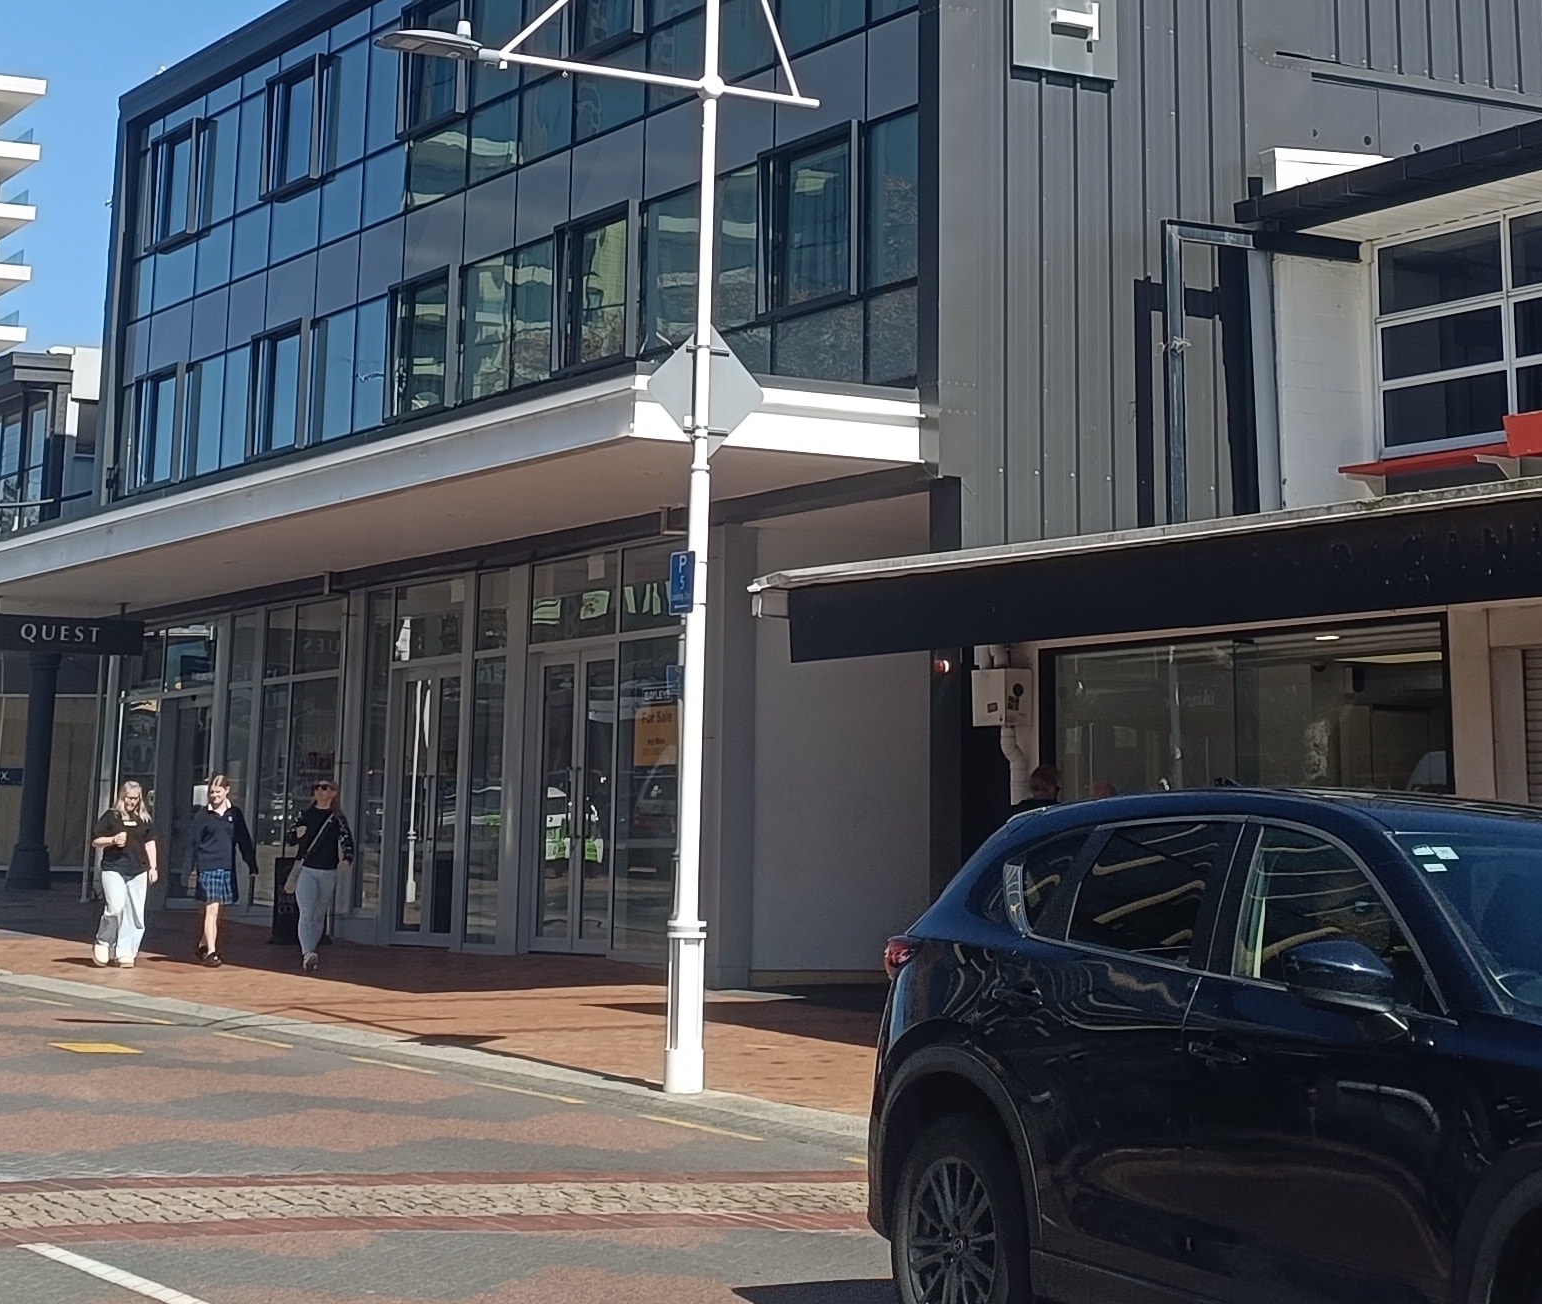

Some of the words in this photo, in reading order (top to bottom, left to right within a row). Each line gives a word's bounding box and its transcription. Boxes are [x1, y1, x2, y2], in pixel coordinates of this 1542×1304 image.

[678, 554, 688, 573] P
[679, 575, 686, 590] 5
[20, 623, 101, 644] QUEST
